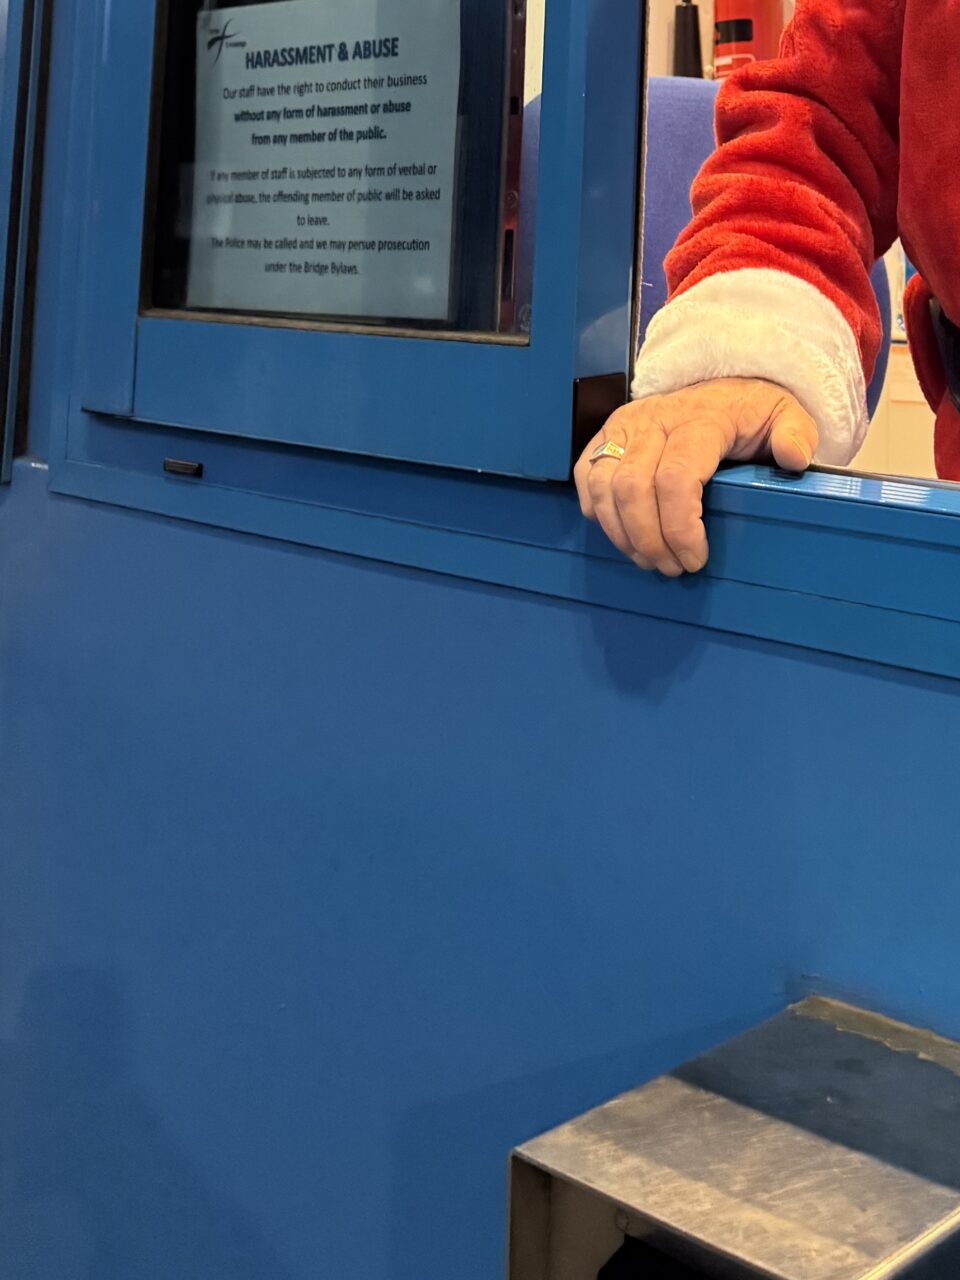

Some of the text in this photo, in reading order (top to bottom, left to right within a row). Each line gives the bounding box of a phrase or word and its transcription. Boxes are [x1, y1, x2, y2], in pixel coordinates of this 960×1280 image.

[246, 37, 399, 70] HARASSMENT & ABUSE
[223, 73, 427, 99] Our staff have the right to conduct their business
[234, 100, 411, 122] without any form of harassment or abuse
[251, 125, 387, 146] from any member of the public.
[261, 168, 270, 180] of
[271, 167, 288, 180] staff
[297, 166, 335, 181] subjected
[337, 166, 346, 178] to
[348, 167, 362, 180] any
[365, 164, 385, 177] form
[387, 163, 397, 176] of
[398, 162, 426, 176] verbal
[427, 164, 438, 175] or
[258, 192, 271, 202] the
[272, 190, 310, 205] offending
[311, 189, 344, 202] member
[346, 189, 356, 201] of
[357, 188, 383, 204] public
[384, 187, 401, 201] will
[402, 188, 413, 200] be
[415, 188, 441, 200] asked
[296, 214, 330, 226] to leave.
[211, 237, 223, 248] The
[246, 239, 261, 250] may
[263, 237, 273, 249] be
[275, 237, 298, 249] called
[299, 238, 314, 249] and
[316, 240, 327, 249] we
[329, 240, 346, 252] may
[348, 240, 376, 253] persue
[378, 239, 430, 253] prosecution
[264, 262, 287, 272] under
[289, 262, 302, 273] the
[304, 261, 329, 275] Bridge
